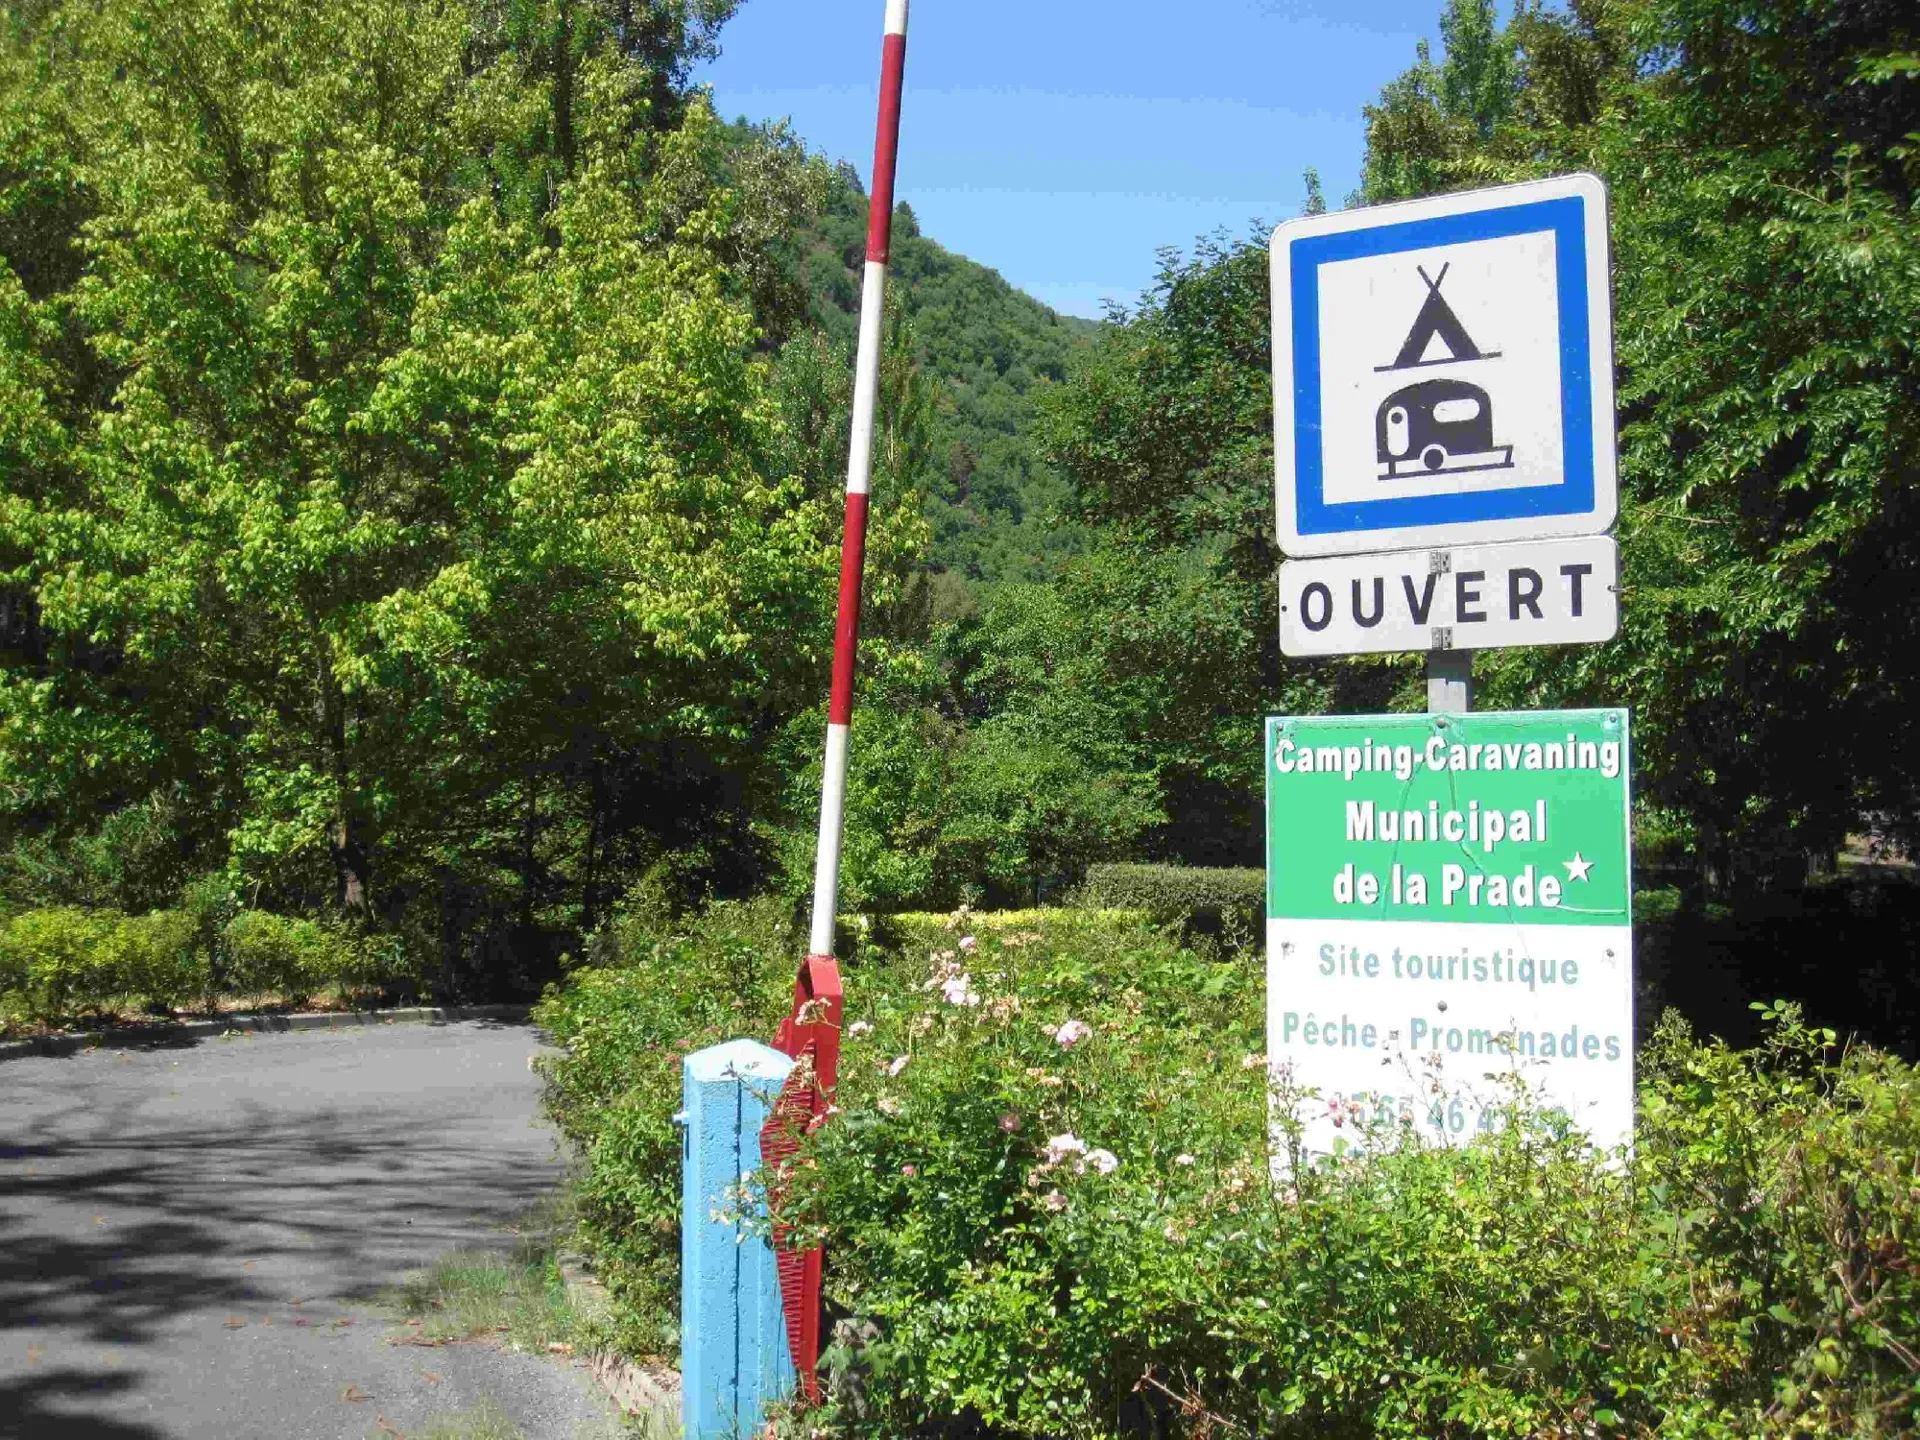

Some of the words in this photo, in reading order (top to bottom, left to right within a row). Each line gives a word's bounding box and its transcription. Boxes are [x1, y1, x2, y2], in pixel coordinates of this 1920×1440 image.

[1300, 563, 1593, 632] OUVERT
[1275, 733, 1621, 780] Camping-Caravaning
[1345, 799, 1548, 852] Municipal
[1332, 862, 1380, 905] de
[1392, 863, 1428, 905] la
[1441, 862, 1562, 907] Prade
[1318, 942, 1381, 979] Site
[1393, 946, 1579, 992] touristique
[1282, 1011, 1378, 1049] Pêche
